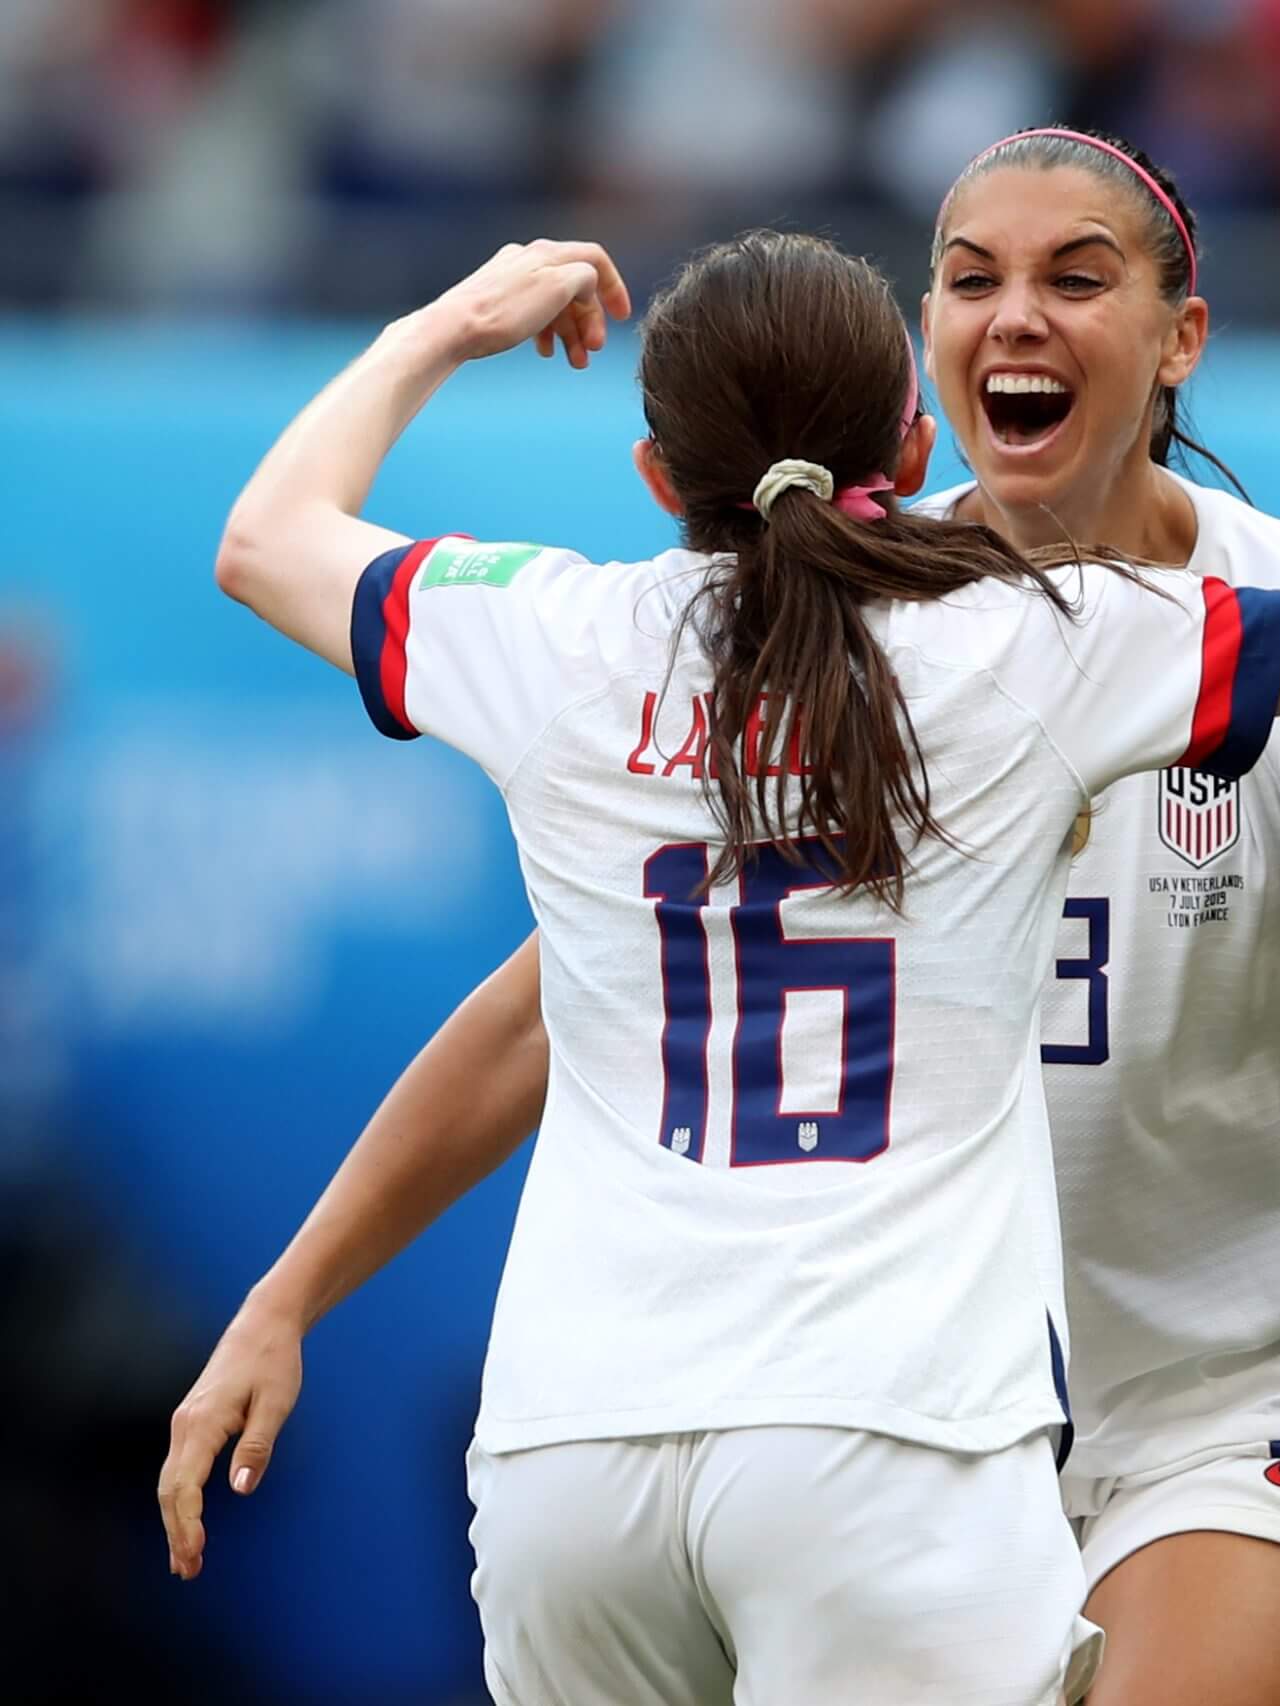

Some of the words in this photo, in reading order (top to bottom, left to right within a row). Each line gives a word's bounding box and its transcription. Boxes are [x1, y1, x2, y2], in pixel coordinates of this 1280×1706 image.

[1166, 767, 1232, 806] USA
[1149, 878, 1169, 892] USA
[1171, 878, 1178, 892] V
[1181, 875, 1244, 892] NETHERLANDS
[1170, 895, 1177, 908] 7
[1180, 896, 1200, 909] JULY
[1204, 892, 1226, 907] 2019
[1168, 913, 1190, 927] LYON
[1194, 908, 1229, 927] FRANCE
[642, 830, 898, 1168] 16
